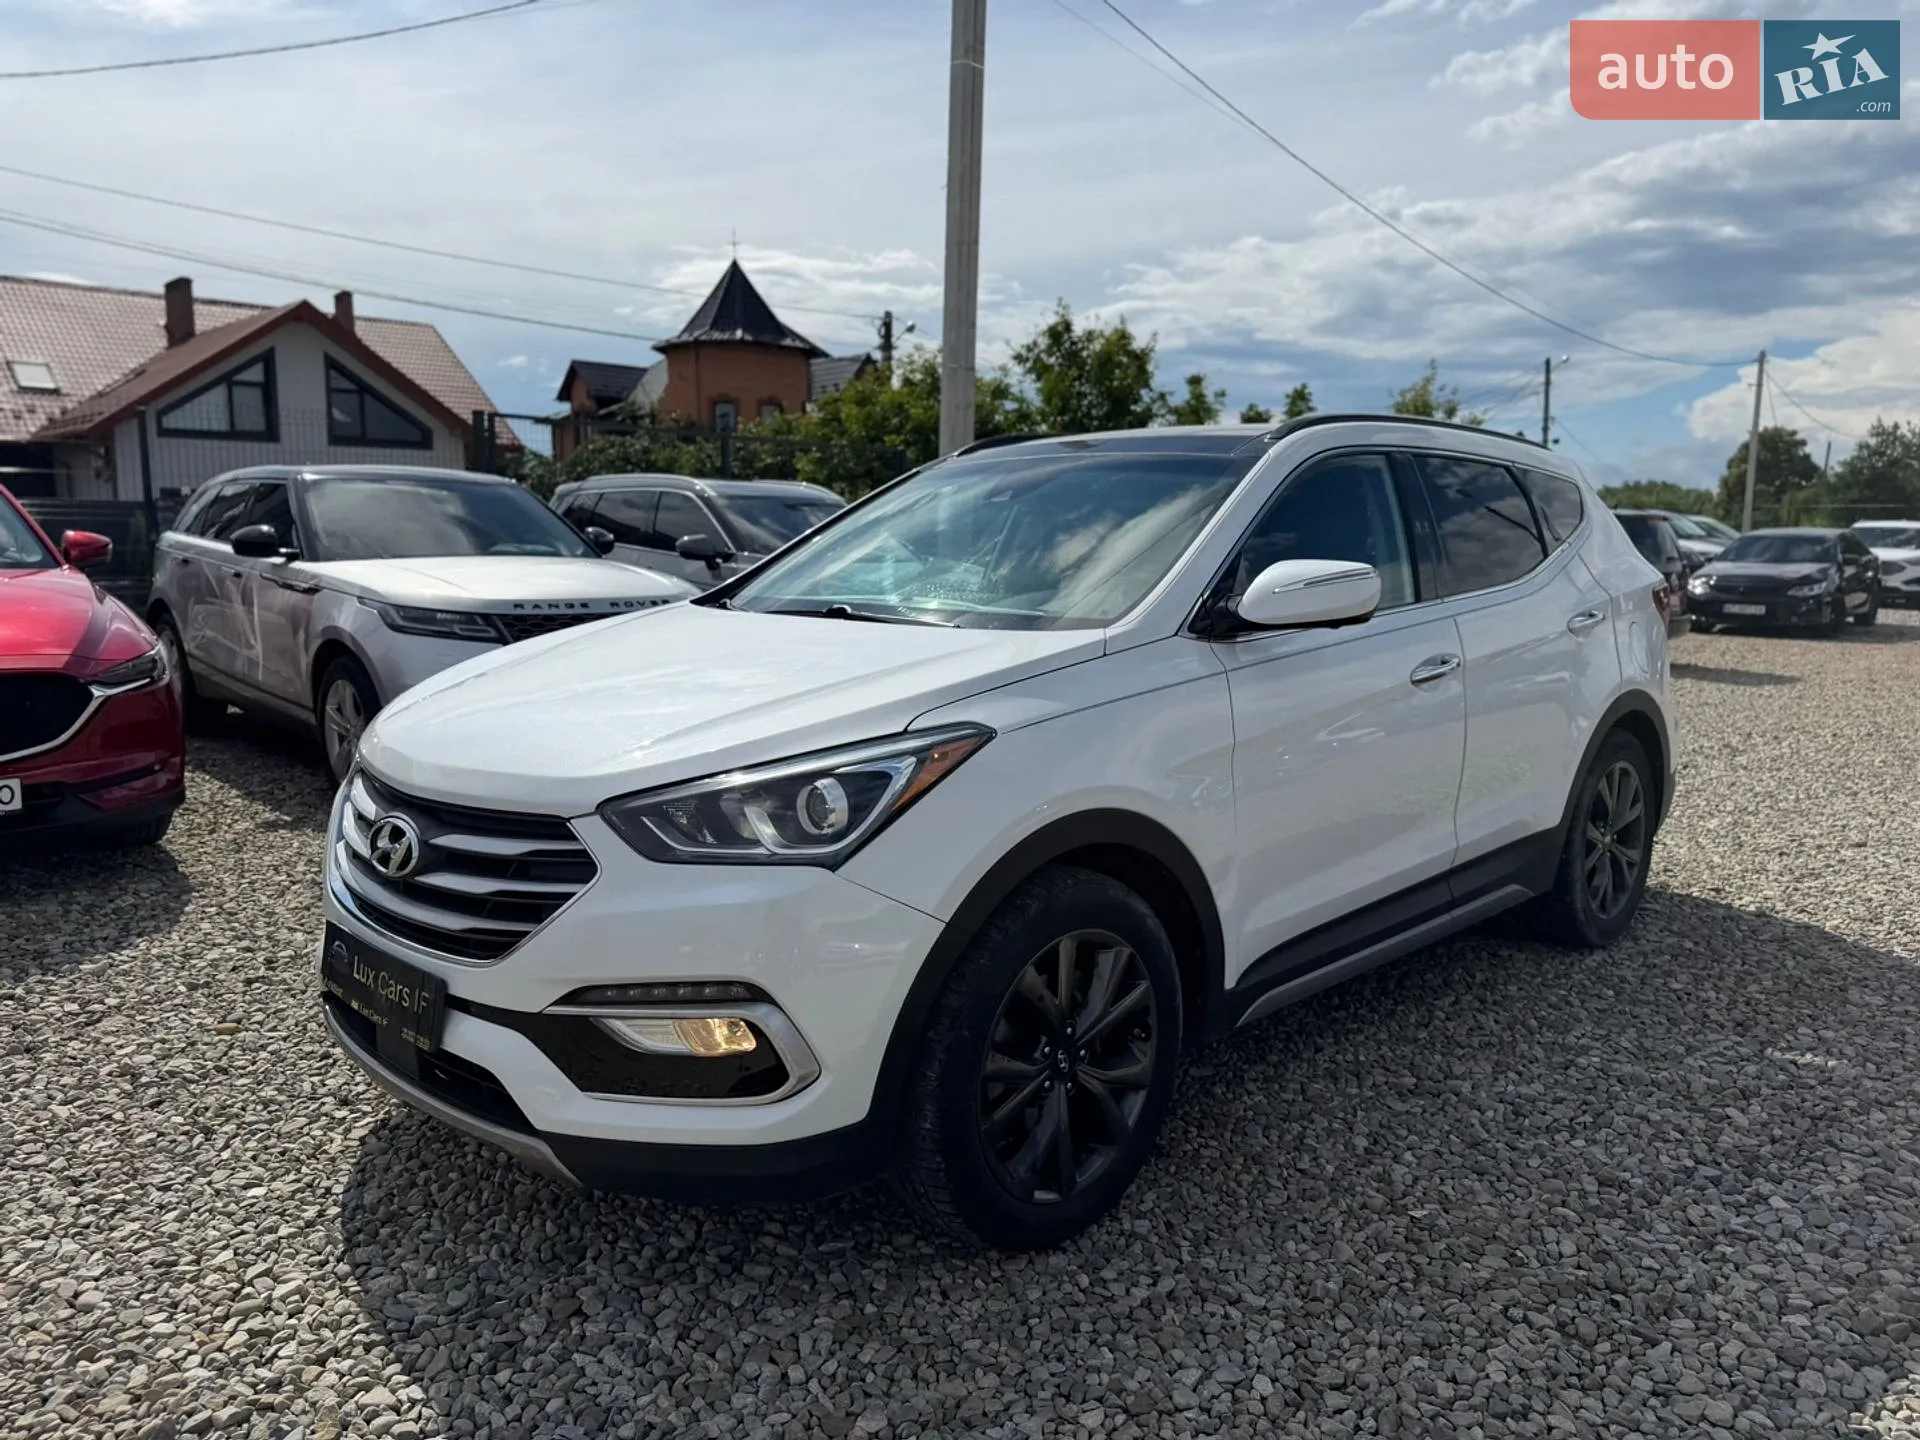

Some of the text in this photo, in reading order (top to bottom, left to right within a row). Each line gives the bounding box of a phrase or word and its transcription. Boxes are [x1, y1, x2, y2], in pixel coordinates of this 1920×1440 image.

[513, 599, 671, 610] RANGE ROVER
[353, 955, 375, 990] Lux
[378, 971, 411, 1008] Cars
[413, 988, 429, 1015] IF
